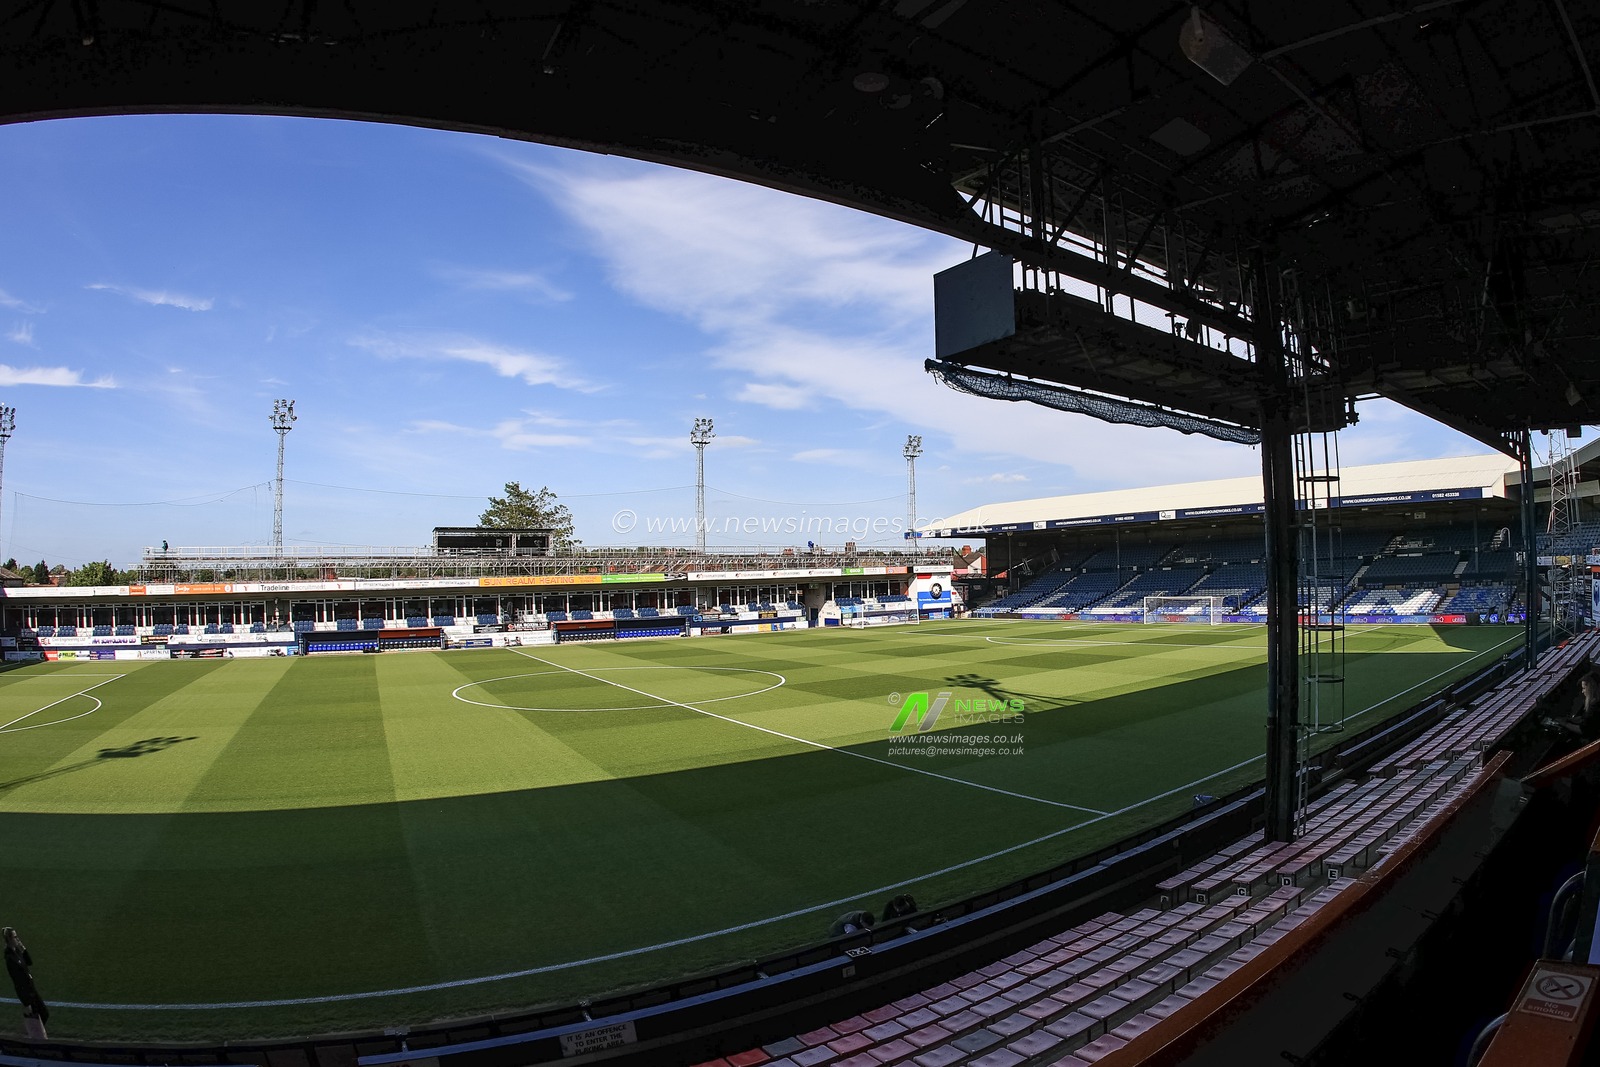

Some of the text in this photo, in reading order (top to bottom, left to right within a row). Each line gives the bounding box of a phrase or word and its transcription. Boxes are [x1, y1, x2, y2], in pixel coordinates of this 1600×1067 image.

[484, 578, 502, 586] SUN
[506, 577, 536, 585] REALM
[540, 576, 575, 584] HEATING
[1527, 1005, 1570, 1017] smoking
[597, 1024, 627, 1036] OFFENCE
[586, 1036, 607, 1045] ENTER
[575, 1039, 625, 1055] PLAYING AREA
